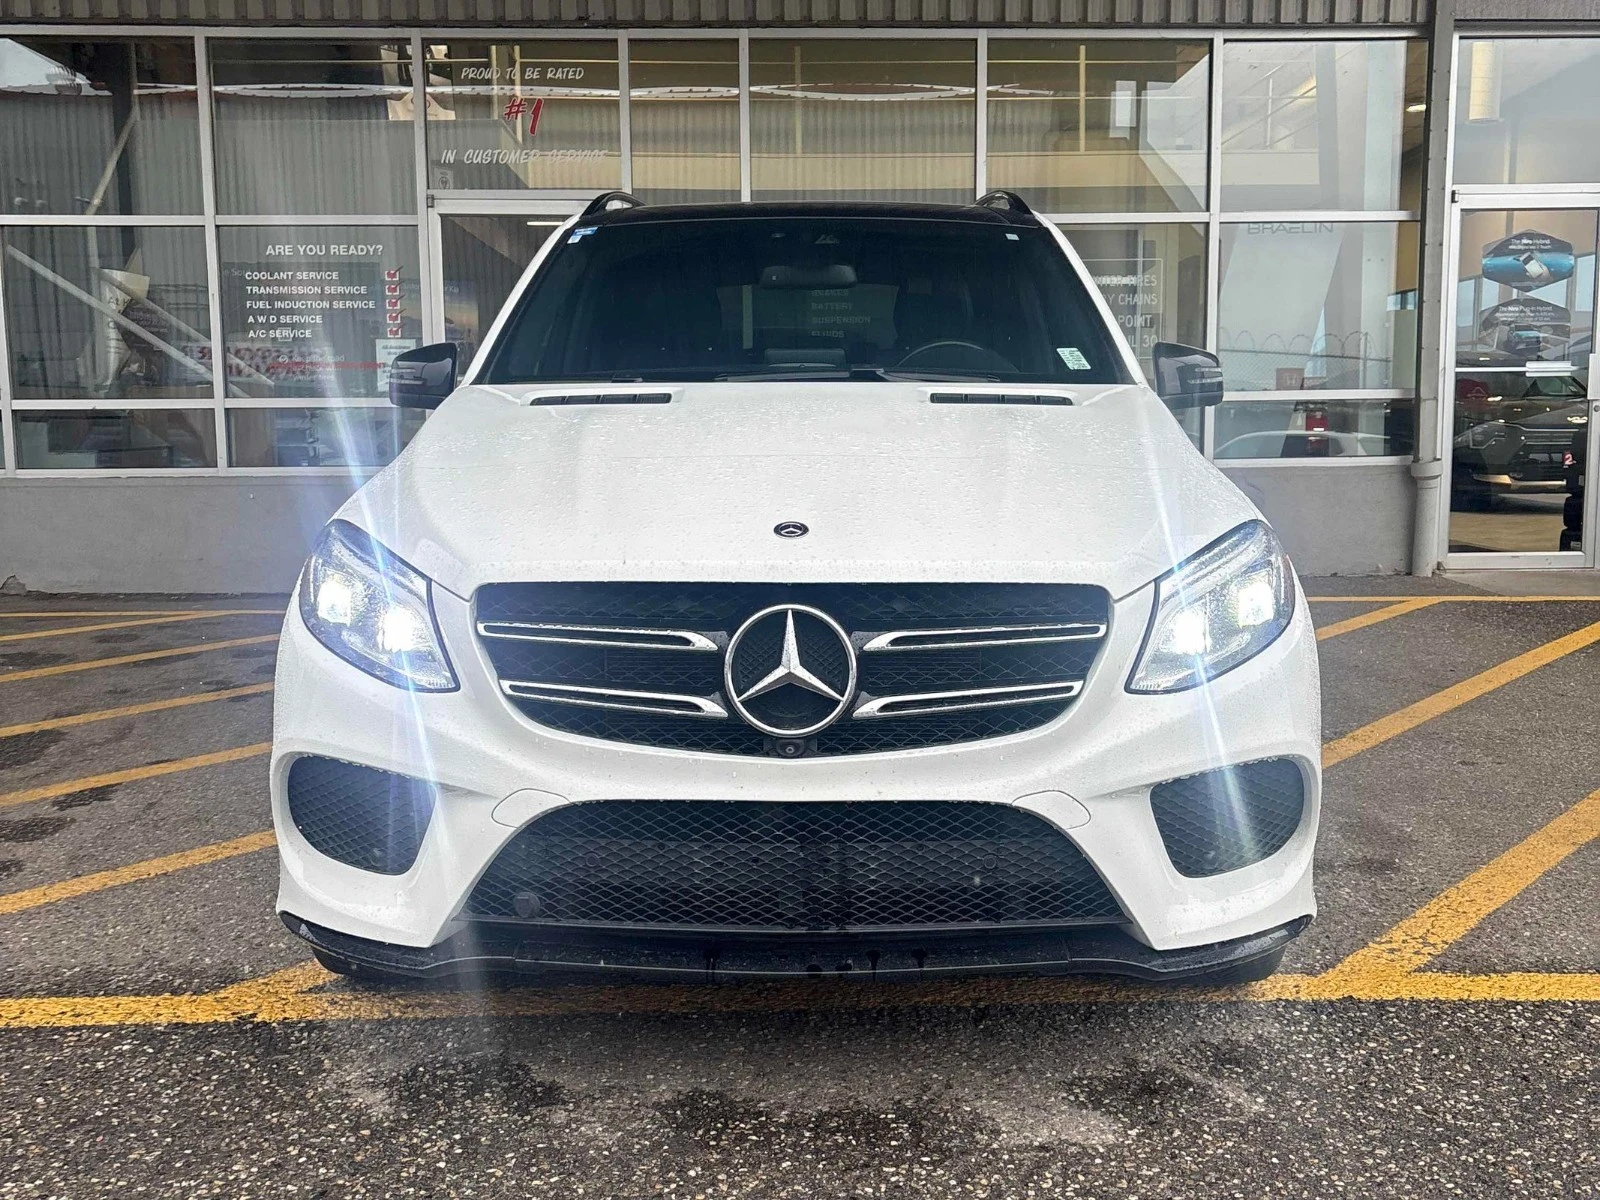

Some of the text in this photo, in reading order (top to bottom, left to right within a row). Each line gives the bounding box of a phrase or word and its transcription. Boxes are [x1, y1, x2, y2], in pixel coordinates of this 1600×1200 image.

[461, 67, 584, 80] PROUD TO BE RATED
[504, 98, 544, 136] #1
[441, 149, 608, 165] IN CUSTOMER SERVICE
[266, 244, 383, 256] ARE YOU READY?
[245, 271, 339, 281] COOLANT SERVICE
[246, 285, 368, 295] TRANSMISSION SERVICE
[246, 300, 376, 309] FUEL INDUCTION SERVICE
[1118, 293, 1158, 305] CHAINS
[247, 314, 323, 324] A W D SERVICE
[1118, 315, 1152, 327] POINT
[248, 330, 313, 338] A/C SERVICE
